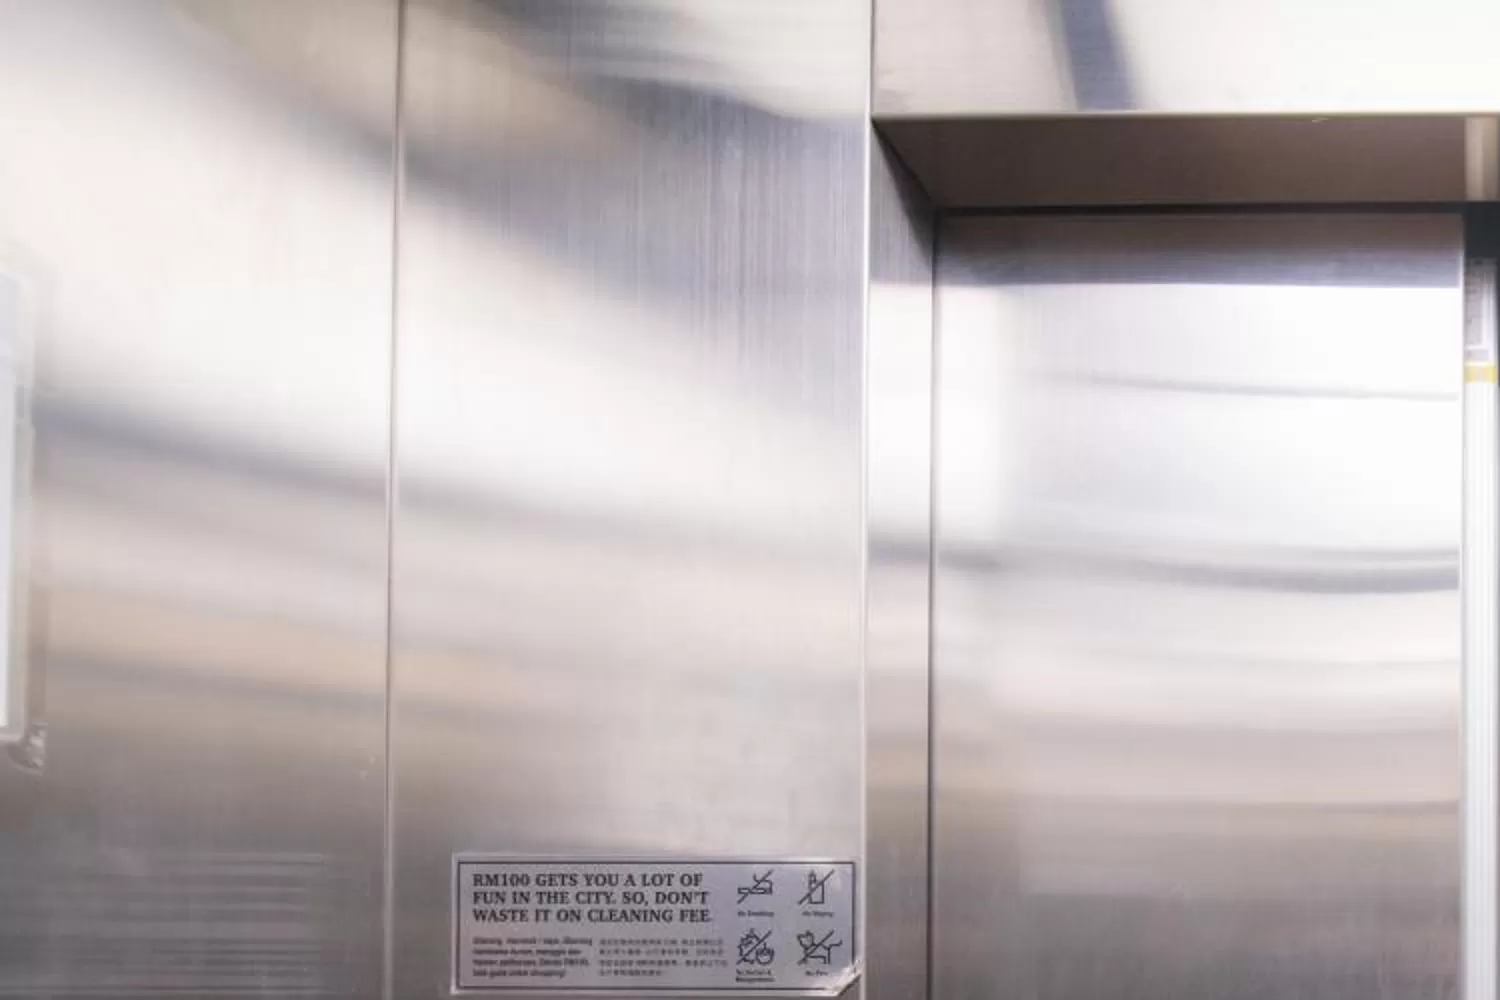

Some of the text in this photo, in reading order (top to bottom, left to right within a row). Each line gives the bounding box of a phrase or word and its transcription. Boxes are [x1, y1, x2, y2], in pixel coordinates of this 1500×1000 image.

[473, 873, 703, 887] RM100 GETS YOU A LOT OF
[473, 891, 506, 905] FUN
[511, 891, 531, 905] IN
[535, 891, 569, 905] THE
[622, 891, 648, 906] SO,
[654, 891, 709, 905] DON'T
[473, 909, 529, 922] WASTE
[535, 909, 551, 922] IT
[556, 909, 582, 922] ON
[587, 909, 673, 922] CLEANING
